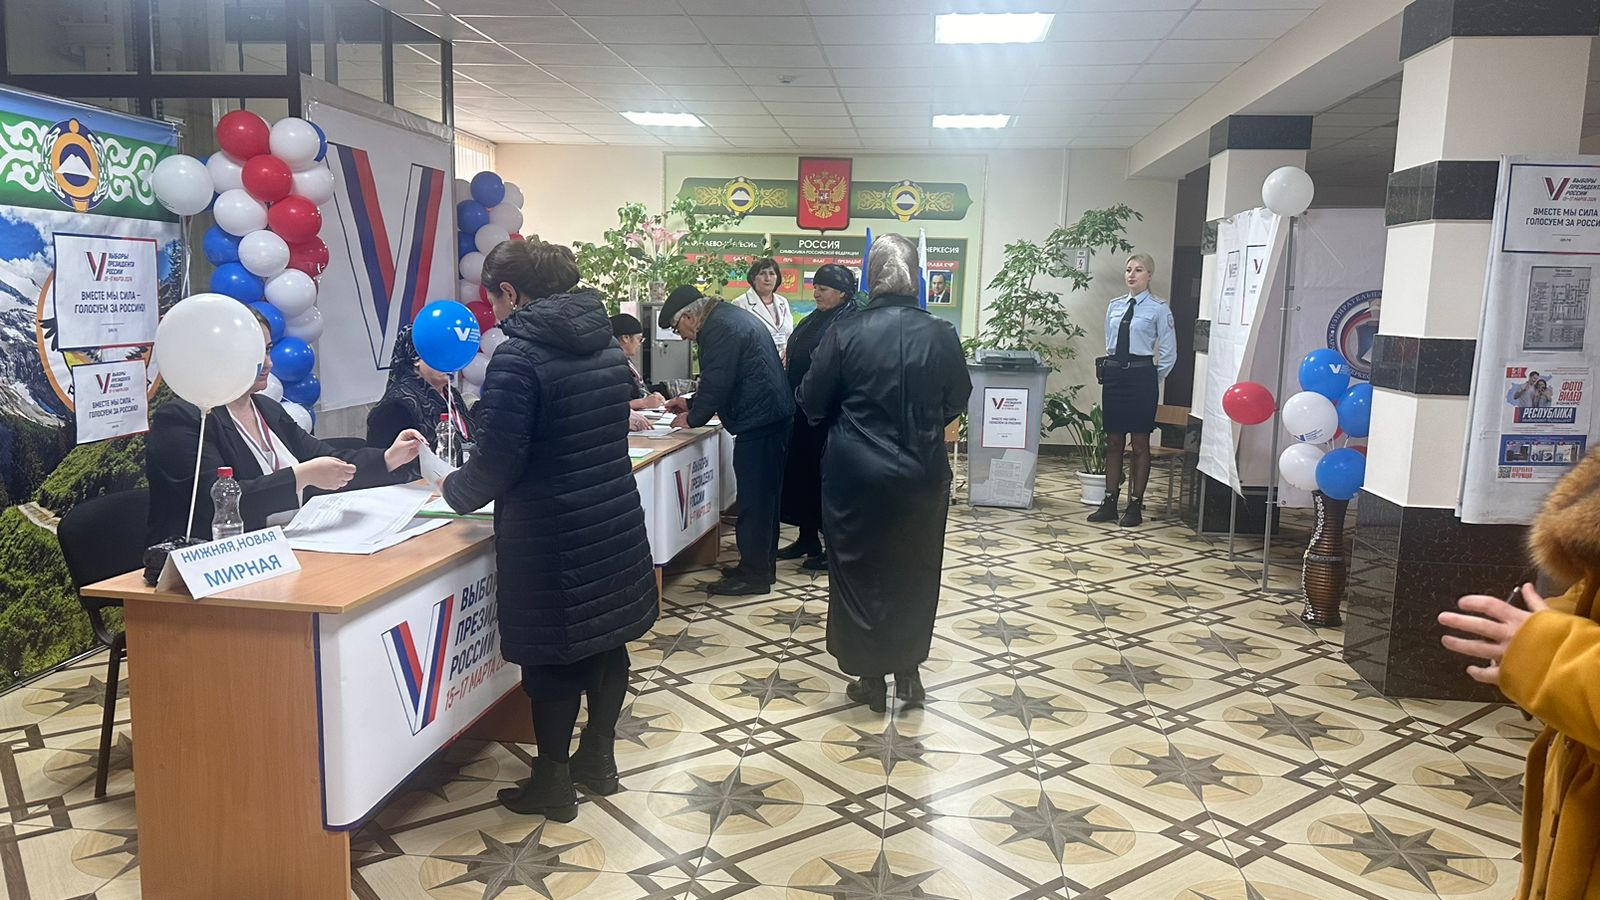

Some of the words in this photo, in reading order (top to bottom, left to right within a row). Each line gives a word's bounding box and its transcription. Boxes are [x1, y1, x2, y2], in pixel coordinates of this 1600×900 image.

[1533, 208, 1561, 216] ВМЕСТЕ
[1578, 209, 1598, 217] СИЛА
[1526, 218, 1564, 226] ГОЛОСУЕМ
[798, 239, 840, 249] РОССИЯ
[81, 291, 105, 300] ВМЕСТЕ
[106, 291, 119, 300] МЫ
[120, 291, 136, 300] СИЛА
[74, 304, 109, 314] ГОЛОСУЕМ
[109, 304, 119, 312] ЗА
[1561, 382, 1583, 392] ФОТО
[1522, 407, 1572, 419] РЕСПУБЛИКА
[203, 554, 282, 588] МИРНАЯ
[449, 629, 496, 681] РОССИИ
[468, 658, 496, 693] МАРТА
